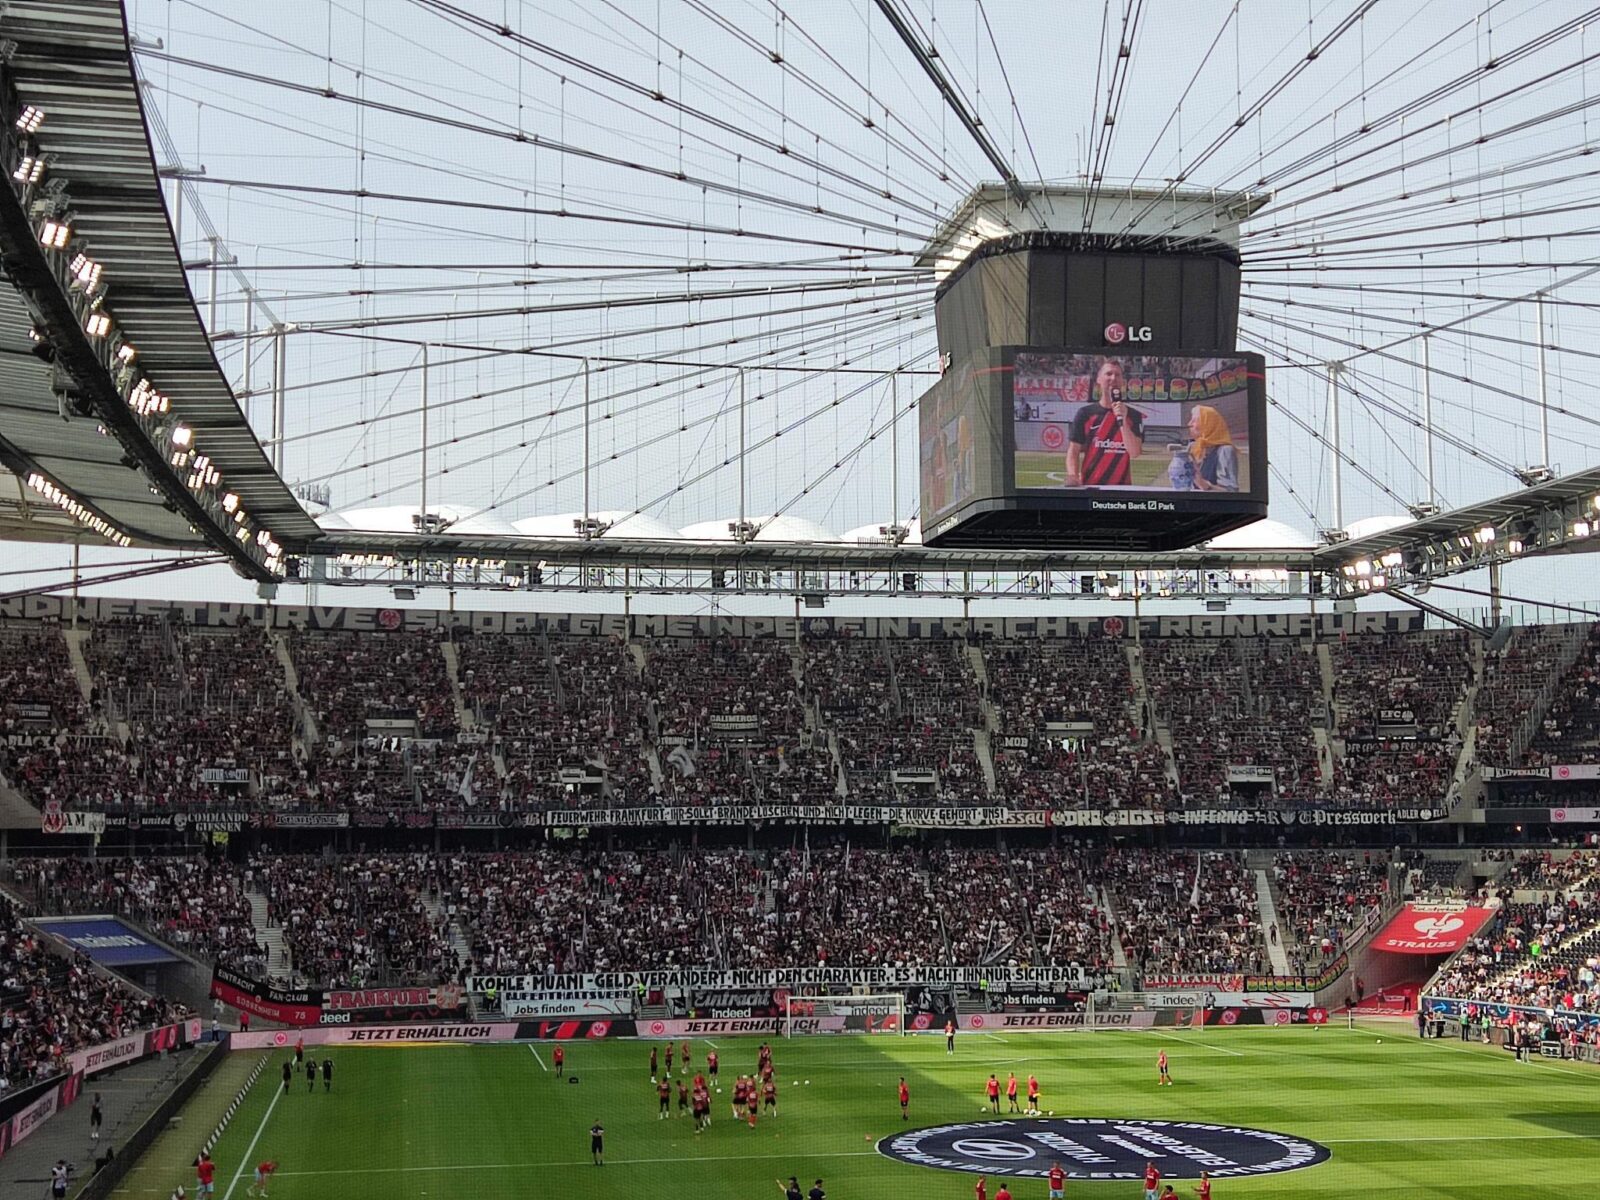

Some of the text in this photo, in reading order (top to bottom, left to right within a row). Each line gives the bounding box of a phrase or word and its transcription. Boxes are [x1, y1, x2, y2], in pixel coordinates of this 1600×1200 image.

[1129, 327, 1152, 341] LG
[1092, 501, 1175, 510] Deutsche Bank Park
[1004, 737, 1028, 747] MOB
[187, 812, 249, 822] COMMANDO
[551, 811, 607, 824] FEUERWEHR
[803, 806, 821, 817] UND
[906, 808, 936, 819] KURVE
[195, 822, 241, 831] GIESSEN
[1387, 939, 1456, 948] STRAUSS
[217, 969, 256, 992] EINTRACHT
[472, 976, 525, 991] KOHLE
[533, 974, 584, 990] MUANI
[733, 970, 771, 984] NICHT
[776, 969, 802, 983] DEN
[895, 968, 910, 982] ES
[916, 968, 959, 982] MACHT
[963, 968, 982, 982] IHN
[986, 968, 1011, 981] NUR
[1016, 967, 1079, 981] SICHTBAR
[330, 987, 430, 1009] FRANKFURT
[1022, 995, 1056, 1005] finden
[1163, 996, 1197, 1005] indee
[514, 1003, 575, 1015] Jobs finden
[711, 1008, 751, 1018] indeed
[320, 1013, 350, 1023] deed
[1003, 1016, 1046, 1026] JETZT
[685, 1021, 729, 1032] JETZT
[347, 1029, 395, 1041] JETZT
